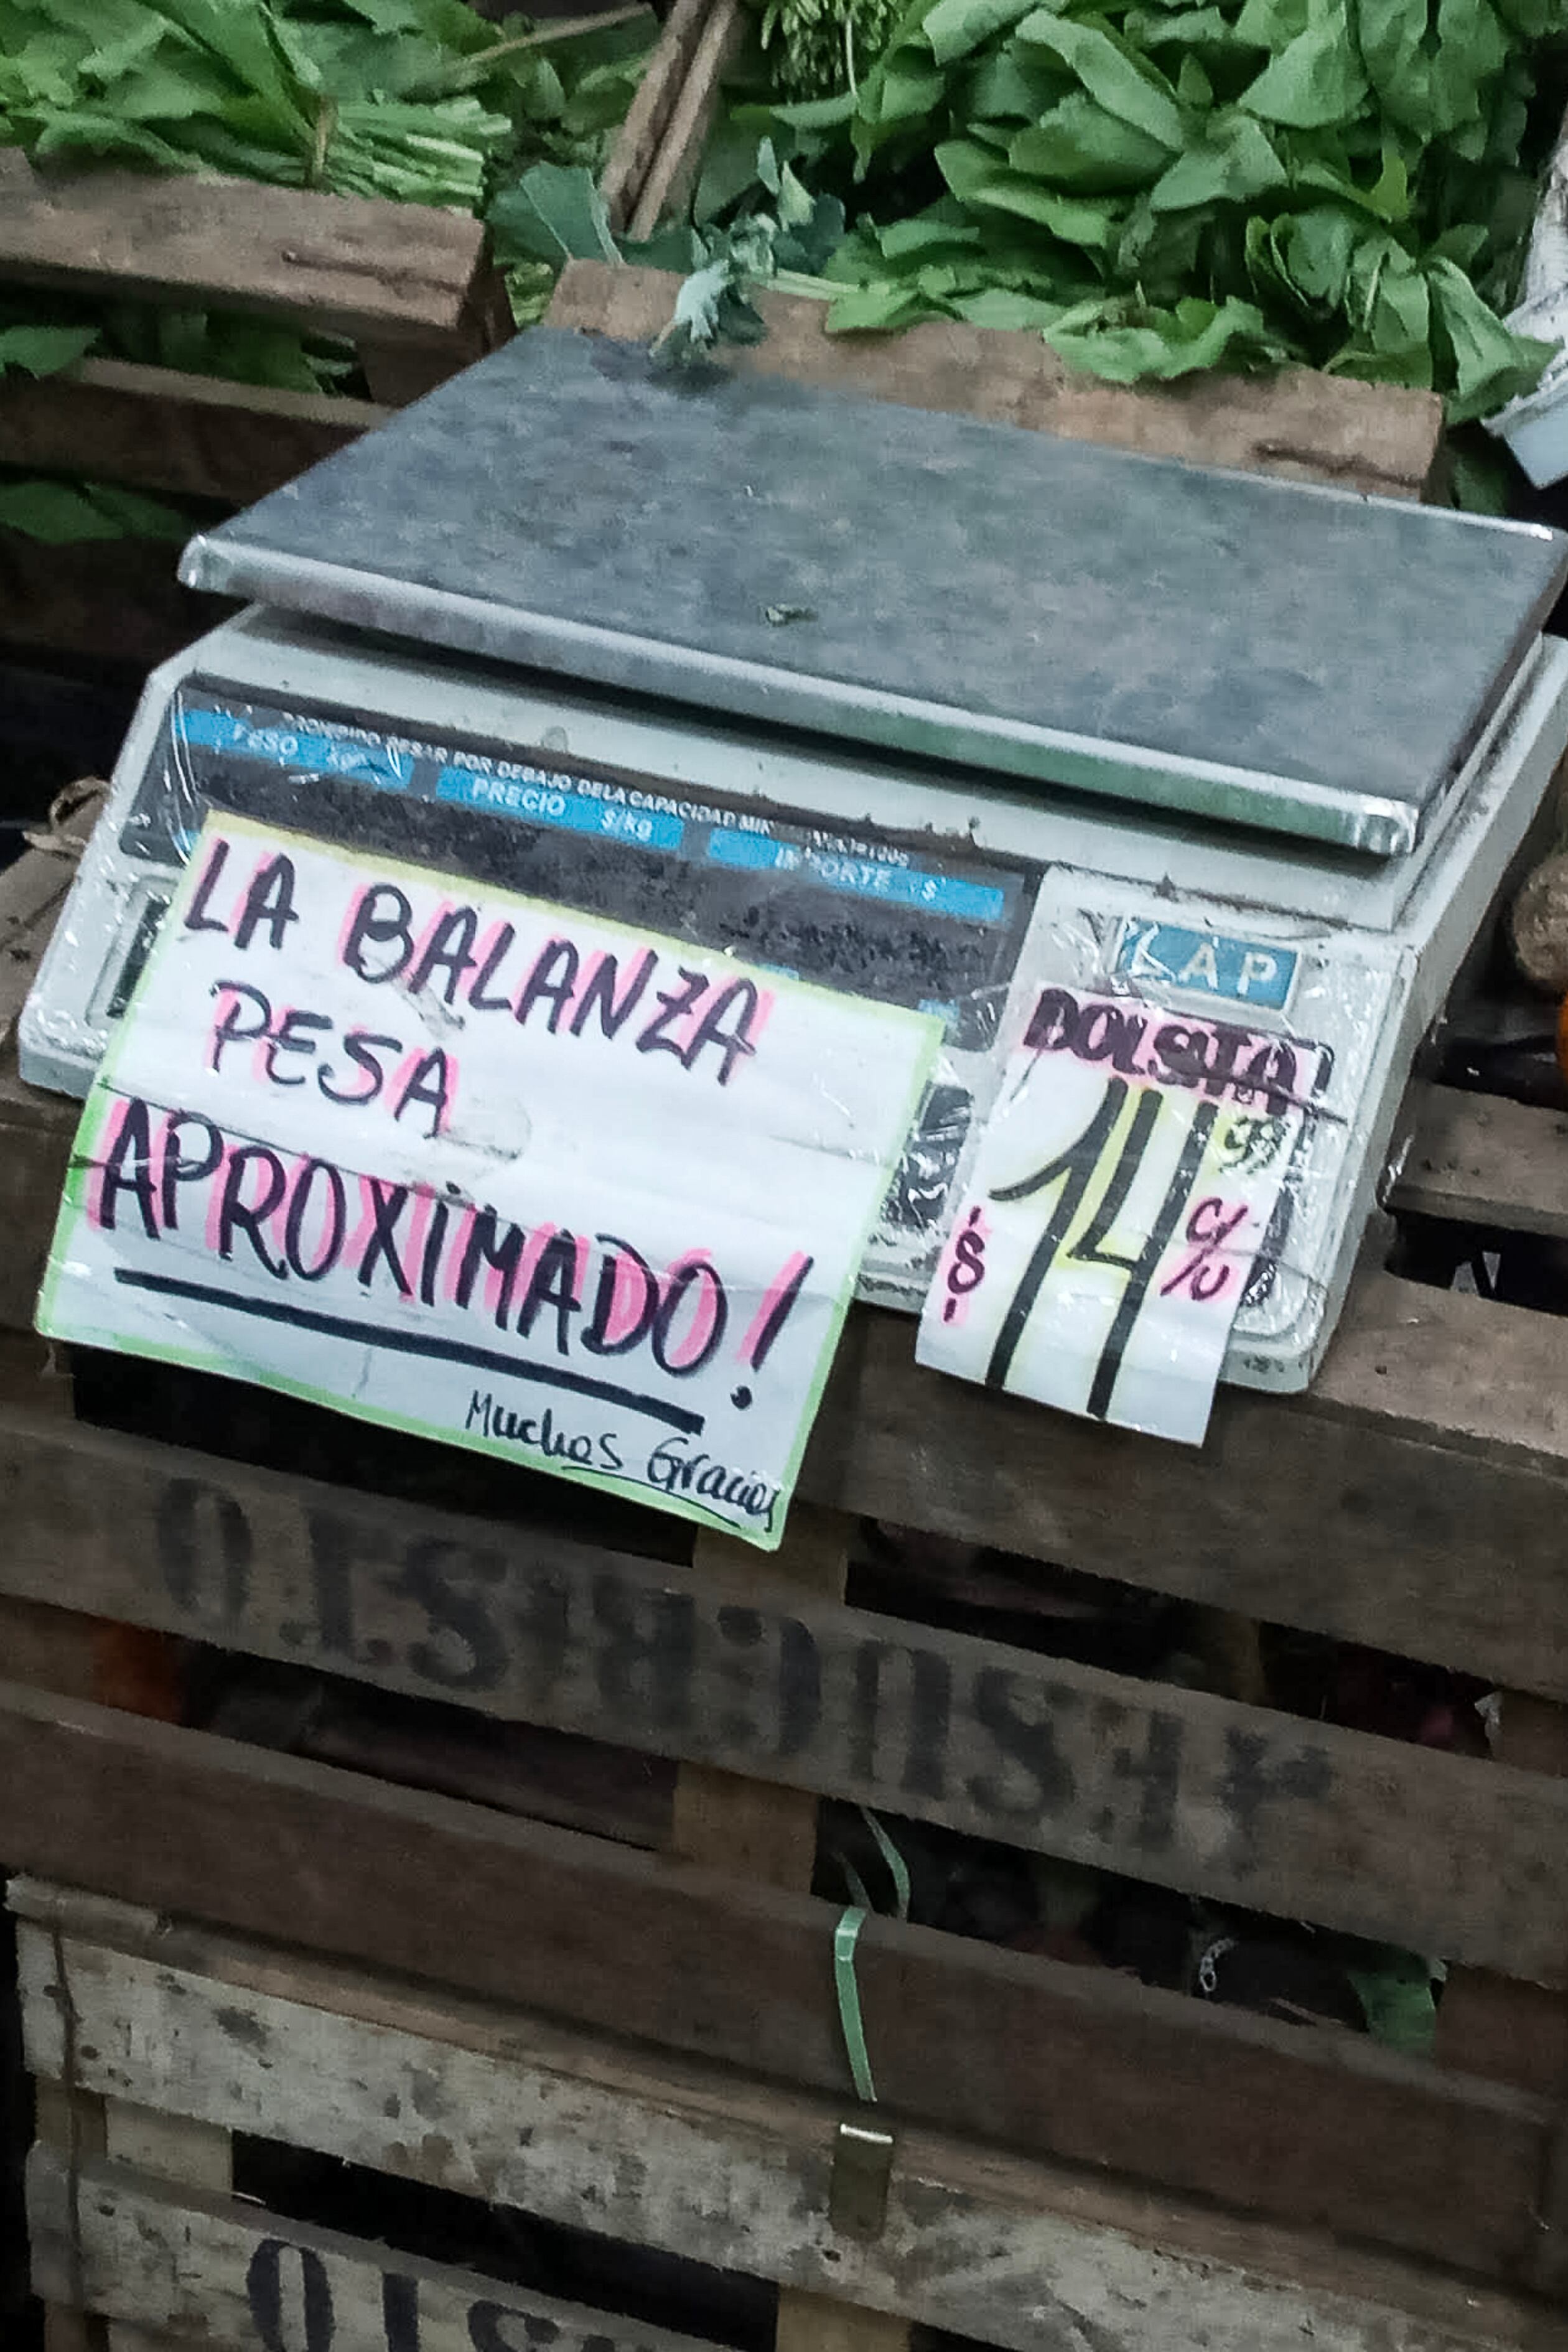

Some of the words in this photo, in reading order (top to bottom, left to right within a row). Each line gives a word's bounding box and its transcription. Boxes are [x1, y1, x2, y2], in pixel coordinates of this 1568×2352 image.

[473, 777, 565, 817] PRECIO
[497, 760, 572, 793] DEBAJO
[628, 791, 736, 828] CAPACIDAD
[184, 838, 300, 950] LA
[340, 883, 760, 1087] BALANZA
[209, 979, 453, 1140] PESA
